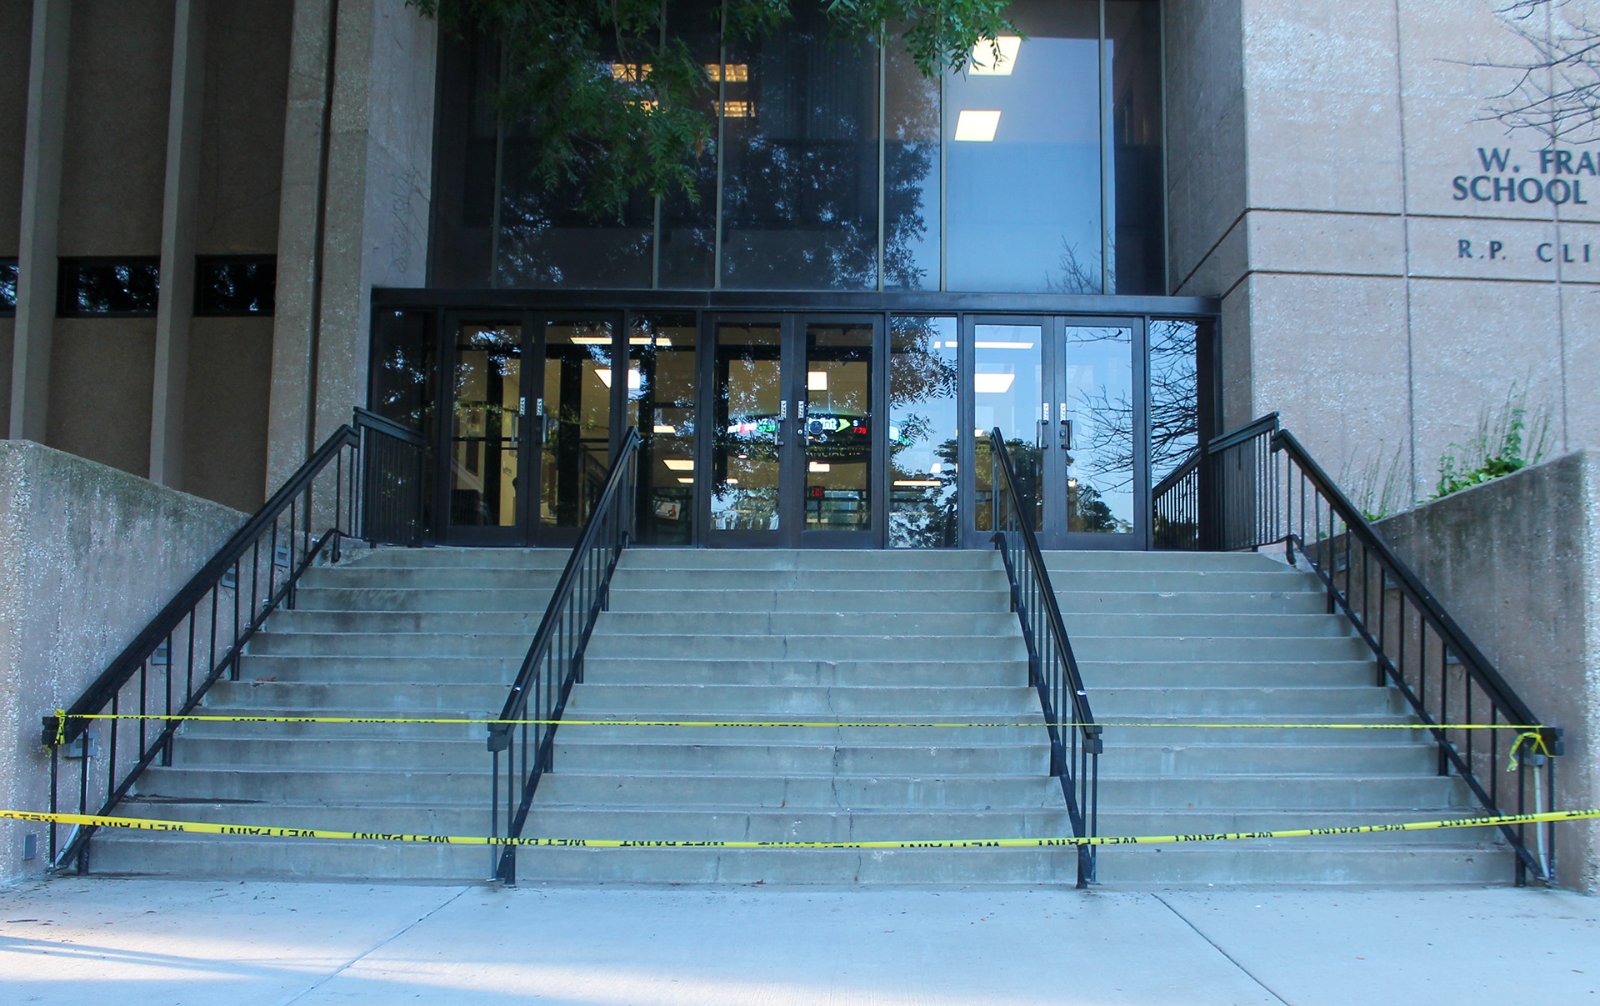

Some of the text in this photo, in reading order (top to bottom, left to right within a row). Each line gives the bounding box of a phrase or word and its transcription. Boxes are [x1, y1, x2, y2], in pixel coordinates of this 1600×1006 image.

[1477, 147, 1600, 176] W. FRA
[1452, 175, 1588, 205] SCHOOL
[1458, 239, 1590, 263] R.P. CLI
